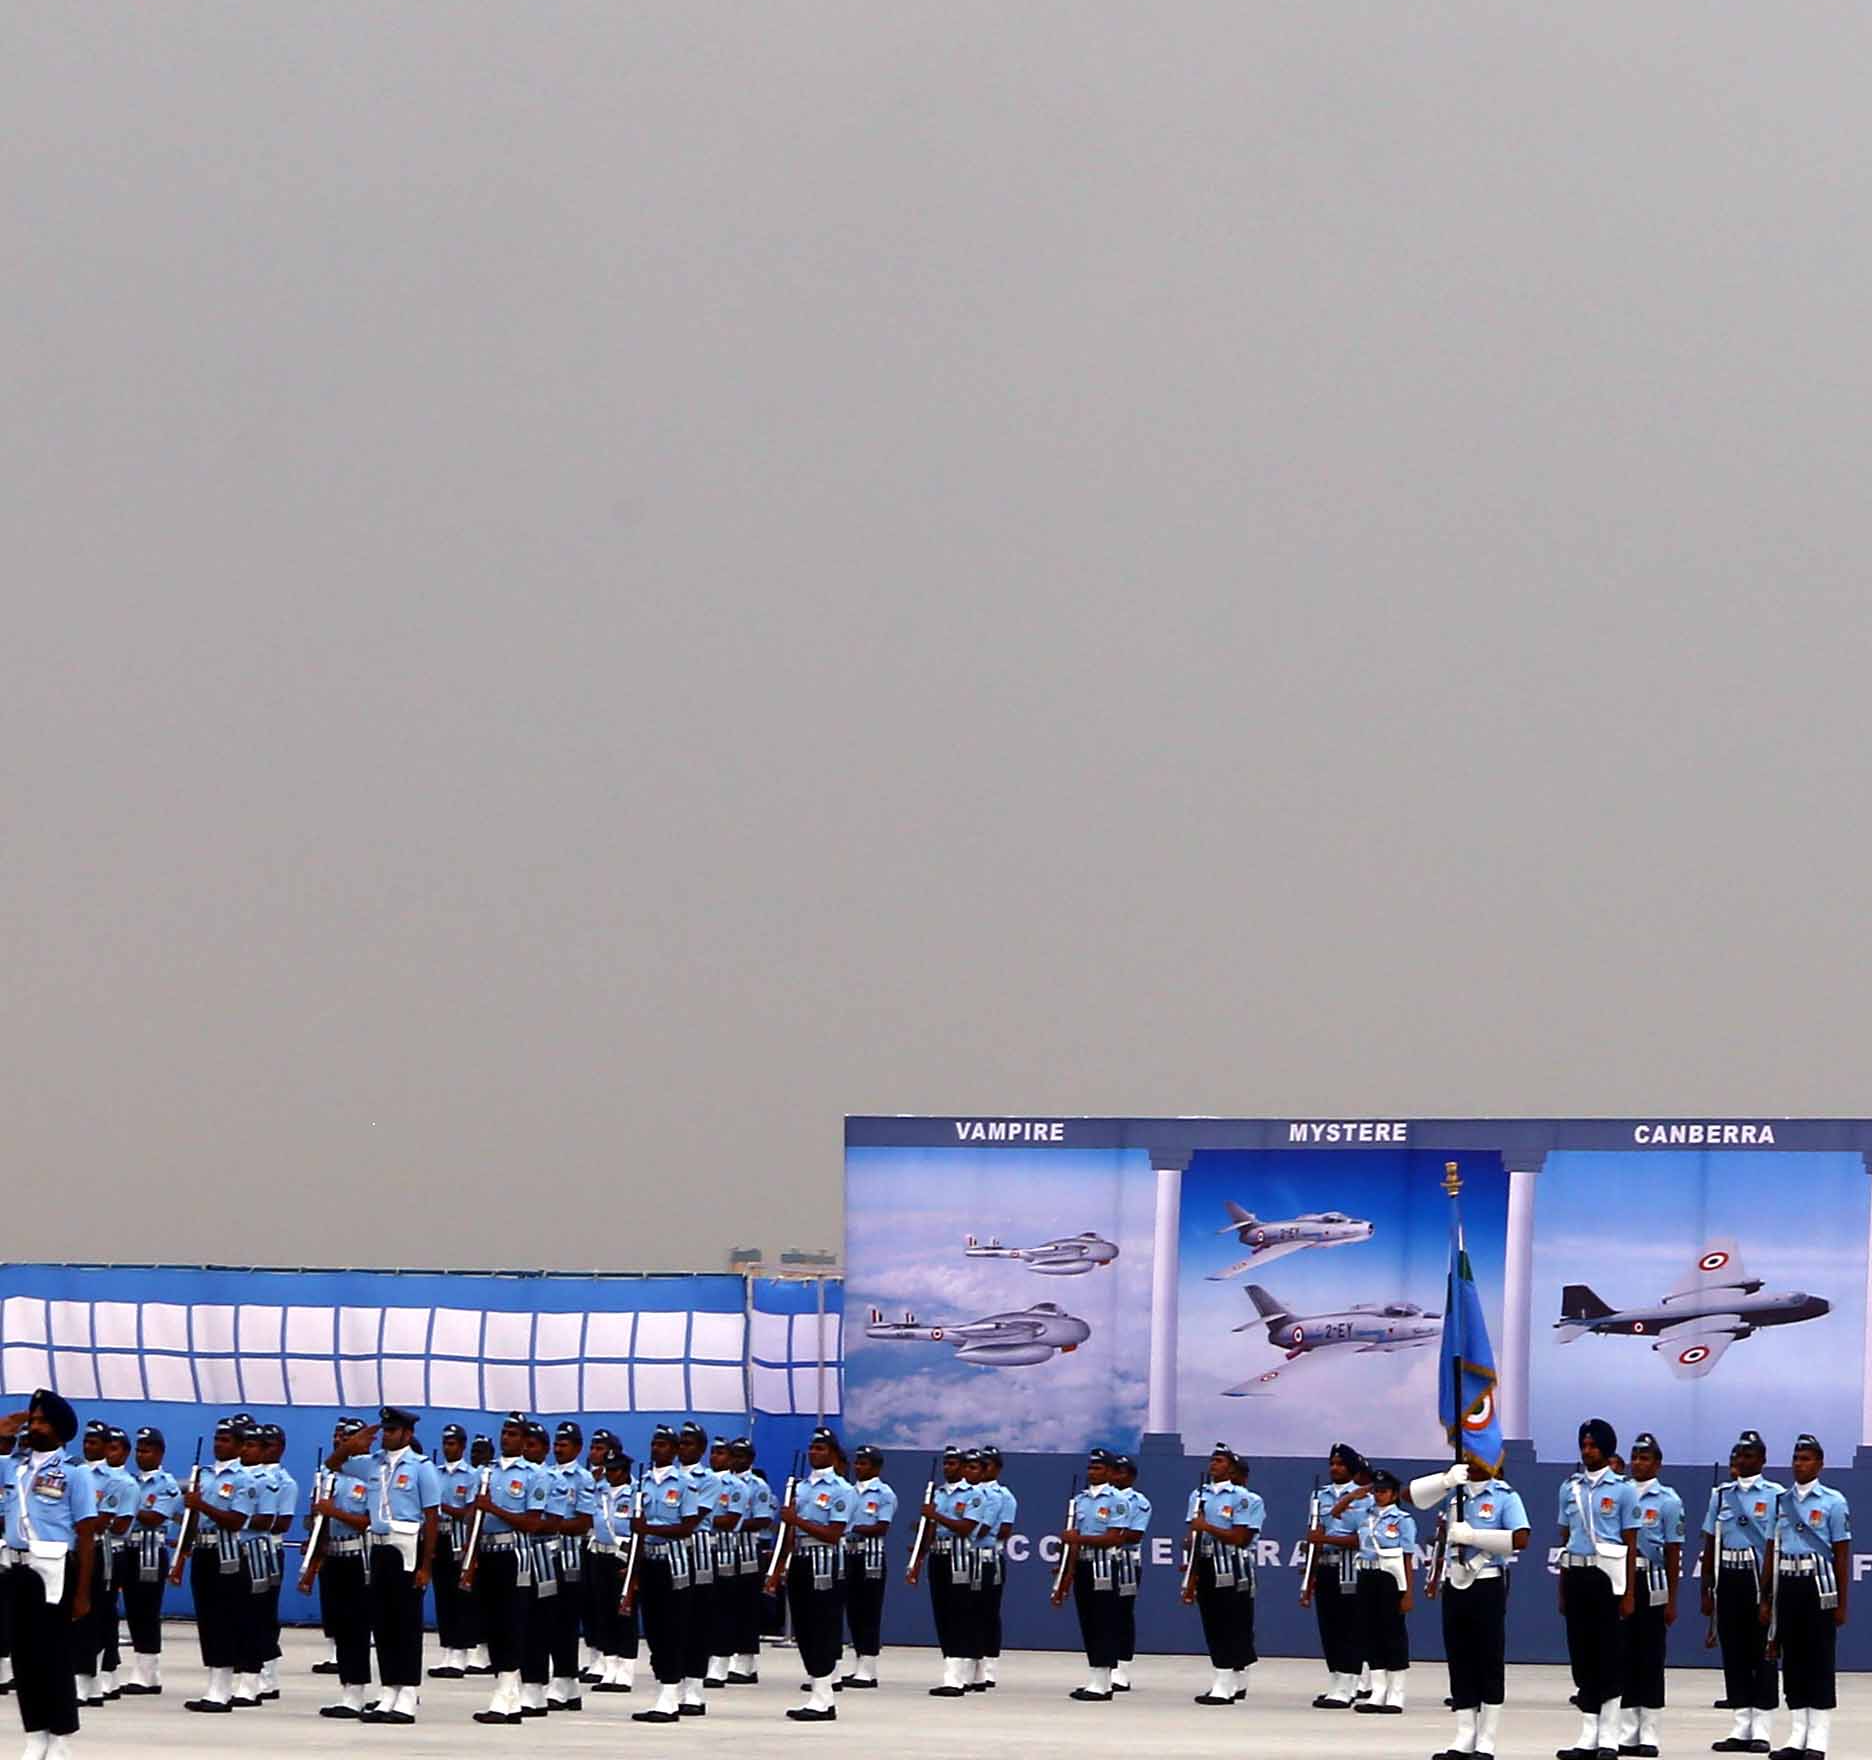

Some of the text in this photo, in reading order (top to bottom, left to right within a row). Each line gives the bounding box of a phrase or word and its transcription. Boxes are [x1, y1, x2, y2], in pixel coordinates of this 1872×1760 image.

[955, 1122, 1065, 1141] VAMPIRE
[1288, 1122, 1408, 1142] MYSTERE
[1633, 1125, 1776, 1144] CANBERRA
[1325, 1322, 1354, 1339] 2-EY
